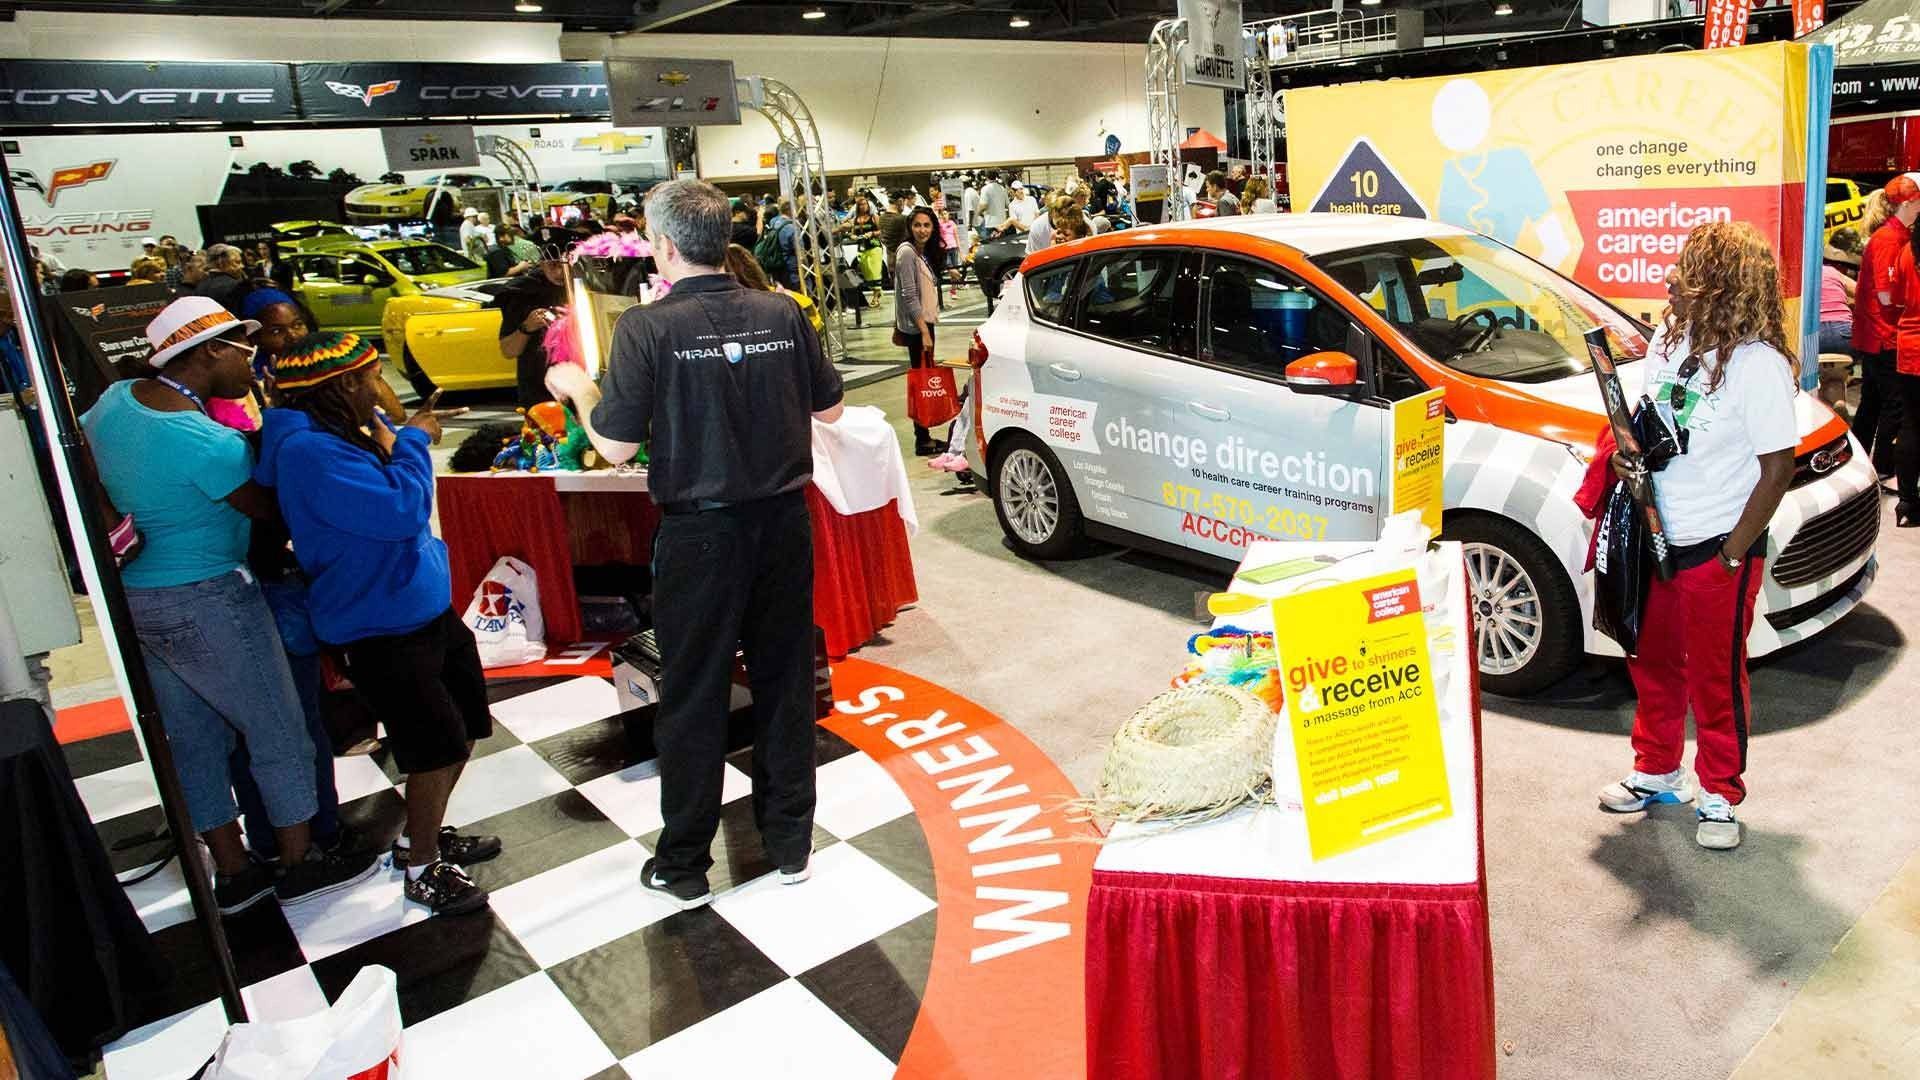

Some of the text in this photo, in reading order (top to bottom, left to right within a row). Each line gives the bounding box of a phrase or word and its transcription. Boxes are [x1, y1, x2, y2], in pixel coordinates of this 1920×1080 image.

[1194, 54, 1235, 80] CORVETTE
[0, 88, 274, 105] ORVETTE
[419, 84, 608, 100] CORVETT
[409, 147, 460, 163] SPARK
[1596, 139, 1688, 158] one change
[1596, 158, 1757, 180] changes everything
[1350, 170, 1379, 198] 10
[1329, 202, 1401, 215] health care
[1597, 201, 1732, 228] american
[1597, 233, 1689, 255] career
[673, 340, 795, 361] VIRAL BOOTH
[1049, 405, 1088, 419] american
[1049, 416, 1077, 428] career
[1049, 427, 1081, 442] college
[1104, 417, 1208, 468] change
[1215, 435, 1374, 497] direction
[1405, 444, 1441, 468] receive
[1191, 467, 1374, 515] 10 health care career training programs
[1162, 481, 1329, 542] 877-570-2037
[1374, 604, 1406, 619] college
[1289, 645, 1418, 693] give to shriners
[1321, 662, 1420, 707] receive
[1303, 685, 1423, 729] a massage from ACC
[834, 685, 1071, 964] WINNER'S
